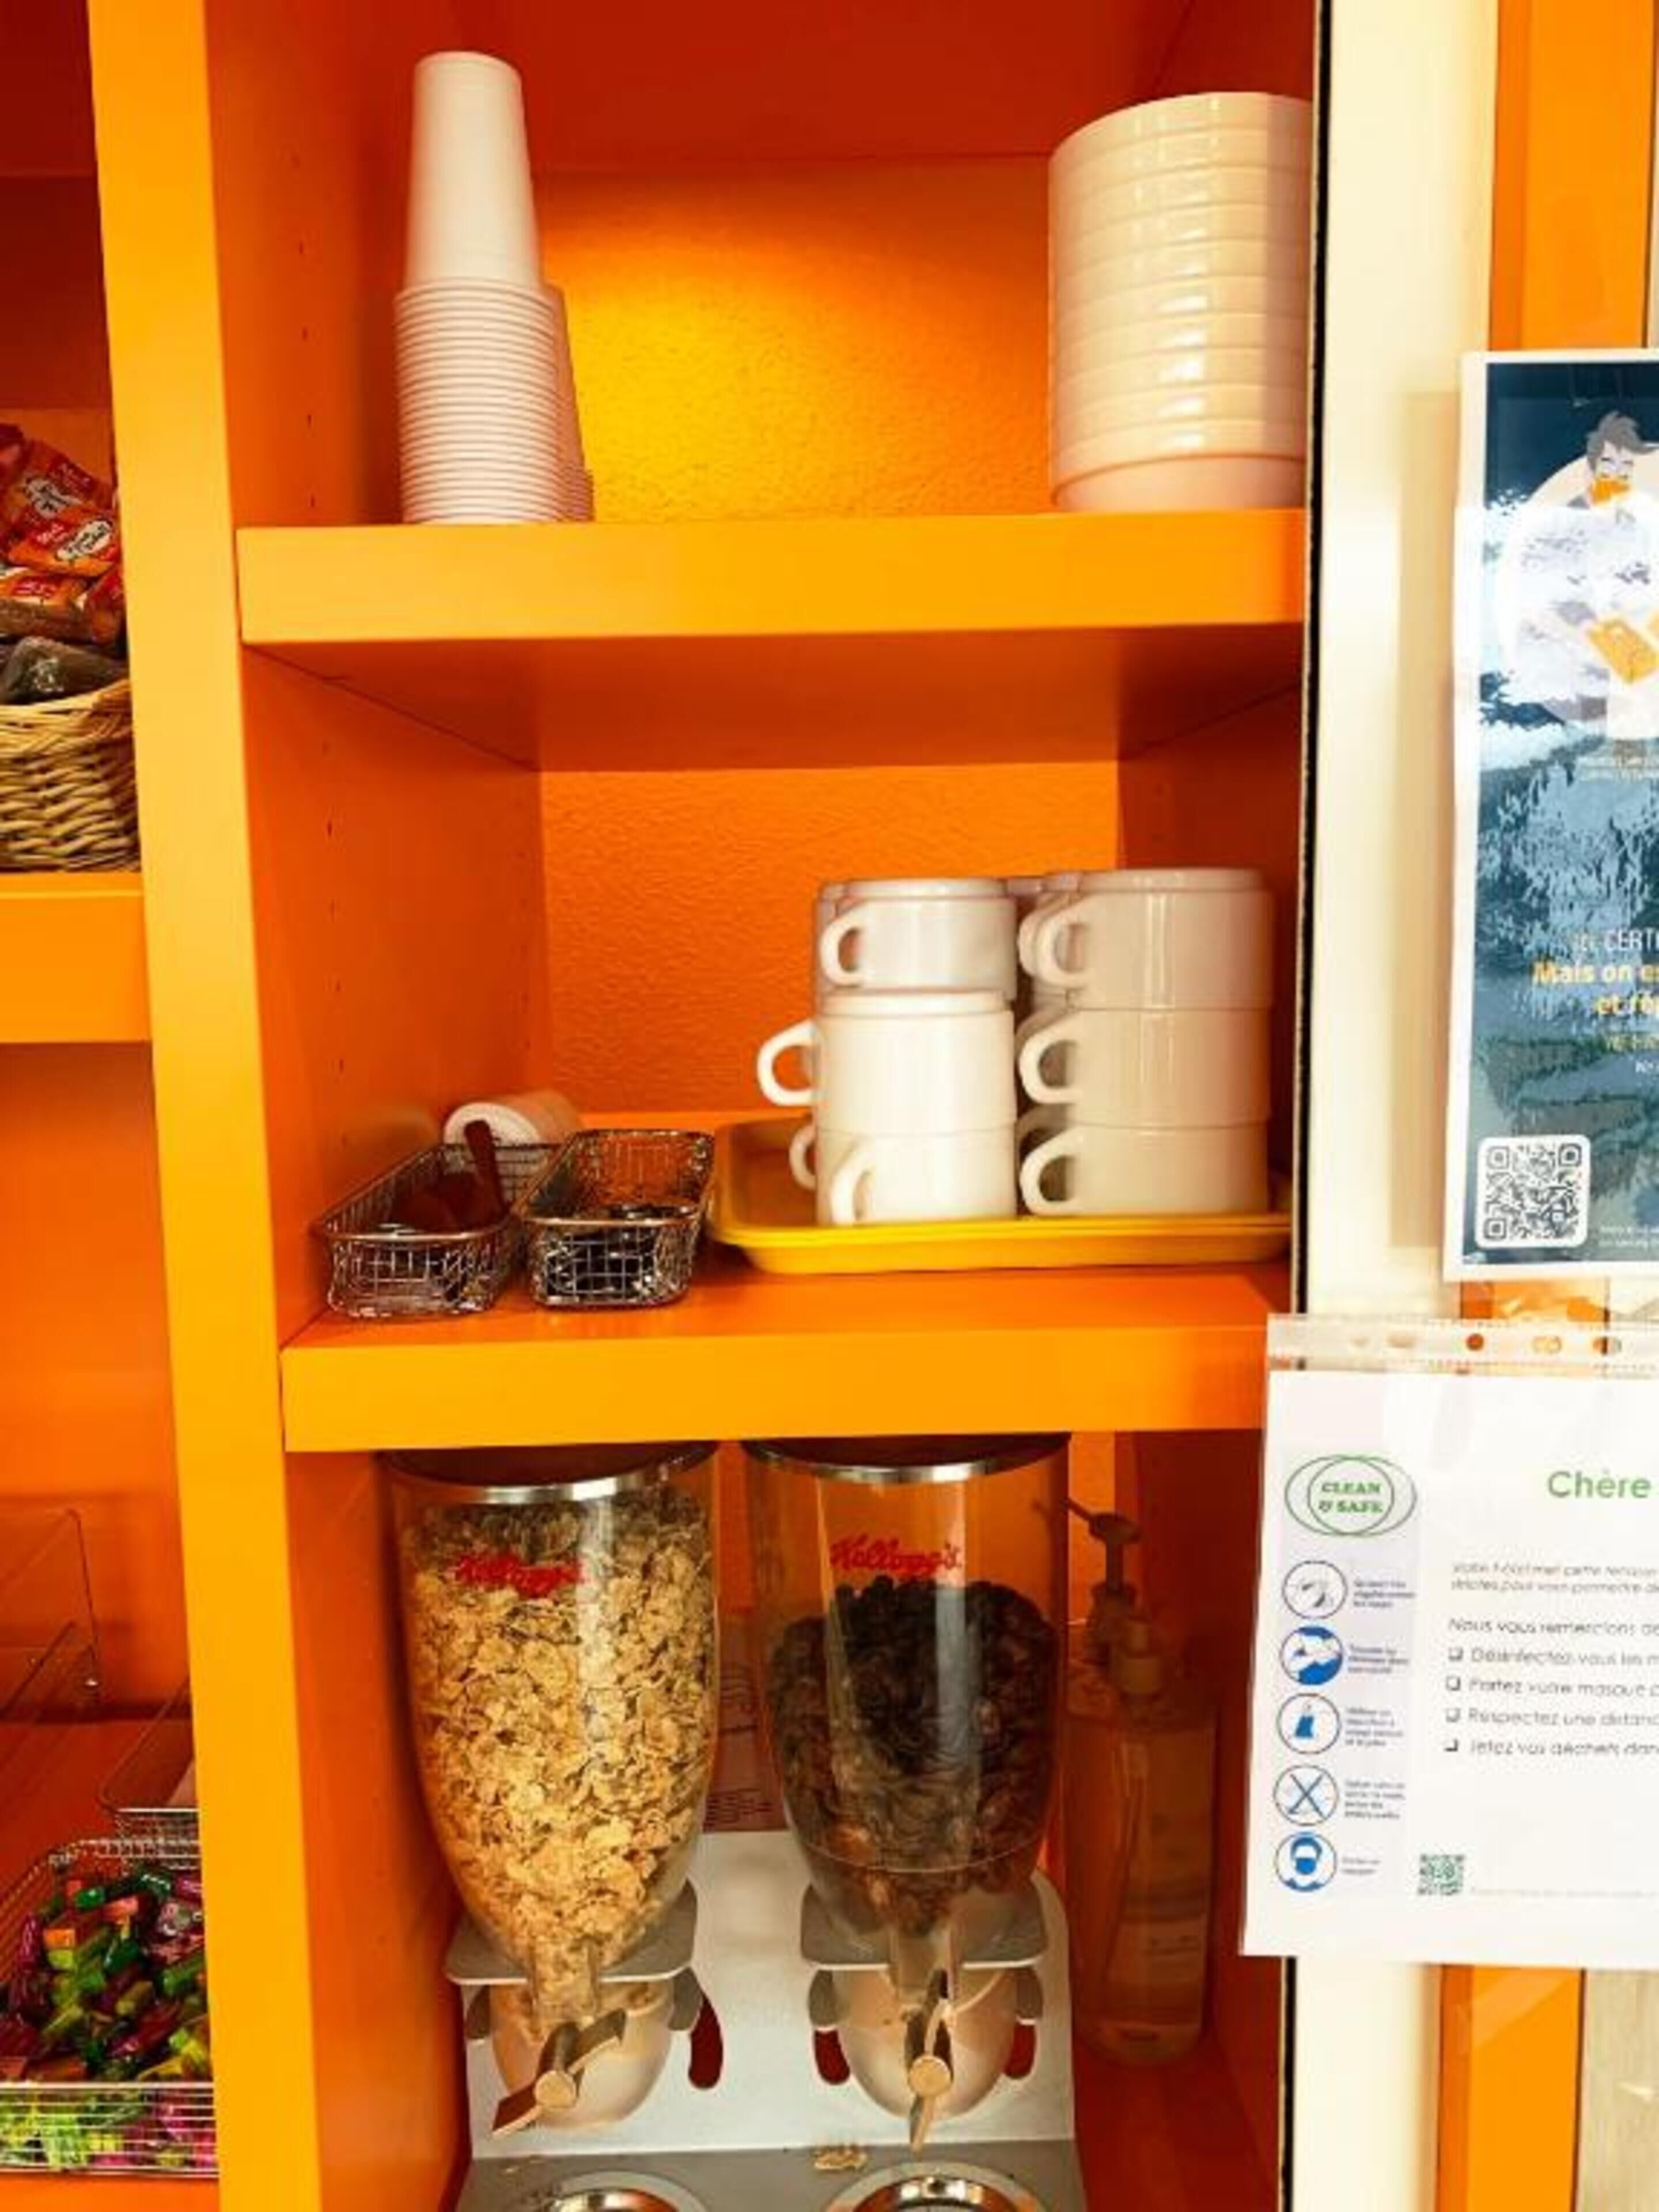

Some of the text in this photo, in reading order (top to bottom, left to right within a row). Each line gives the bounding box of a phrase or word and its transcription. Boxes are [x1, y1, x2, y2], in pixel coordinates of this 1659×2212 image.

[1533, 959, 1594, 983] Mais
[1602, 964, 1633, 982] on
[1321, 1482, 1381, 1494] CLEAN
[1548, 1467, 1652, 1499] Chère
[1336, 1500, 1383, 1513] SAFE
[830, 1533, 963, 1581] Kellogg's
[1497, 1621, 1537, 1635] vous
